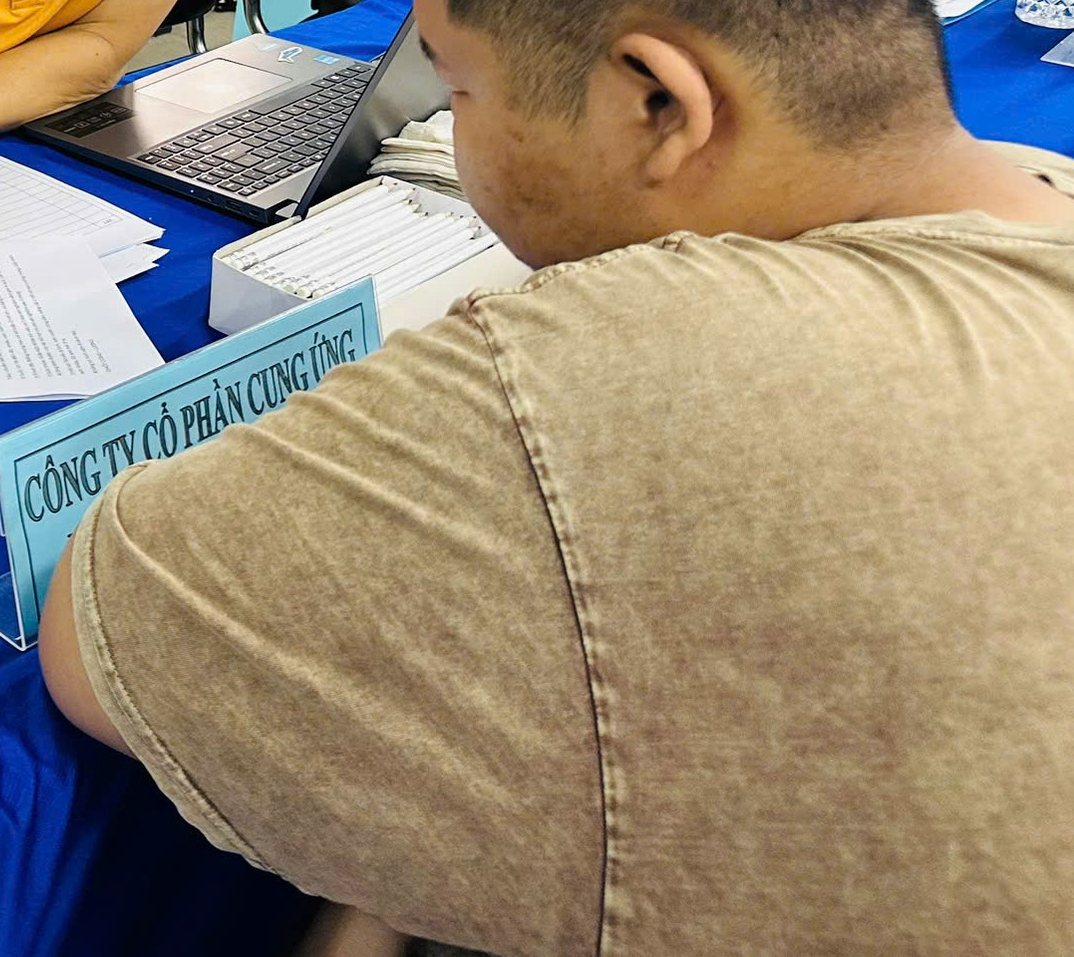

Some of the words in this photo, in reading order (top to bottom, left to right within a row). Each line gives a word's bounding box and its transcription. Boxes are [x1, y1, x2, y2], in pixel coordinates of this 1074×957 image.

[23, 455, 101, 523] CÔNG
[102, 430, 136, 477] TY
[142, 402, 177, 460] CỔ
[180, 378, 245, 450] PHẦN
[247, 352, 308, 416] CUNG
[309, 329, 355, 383] ỨNG
